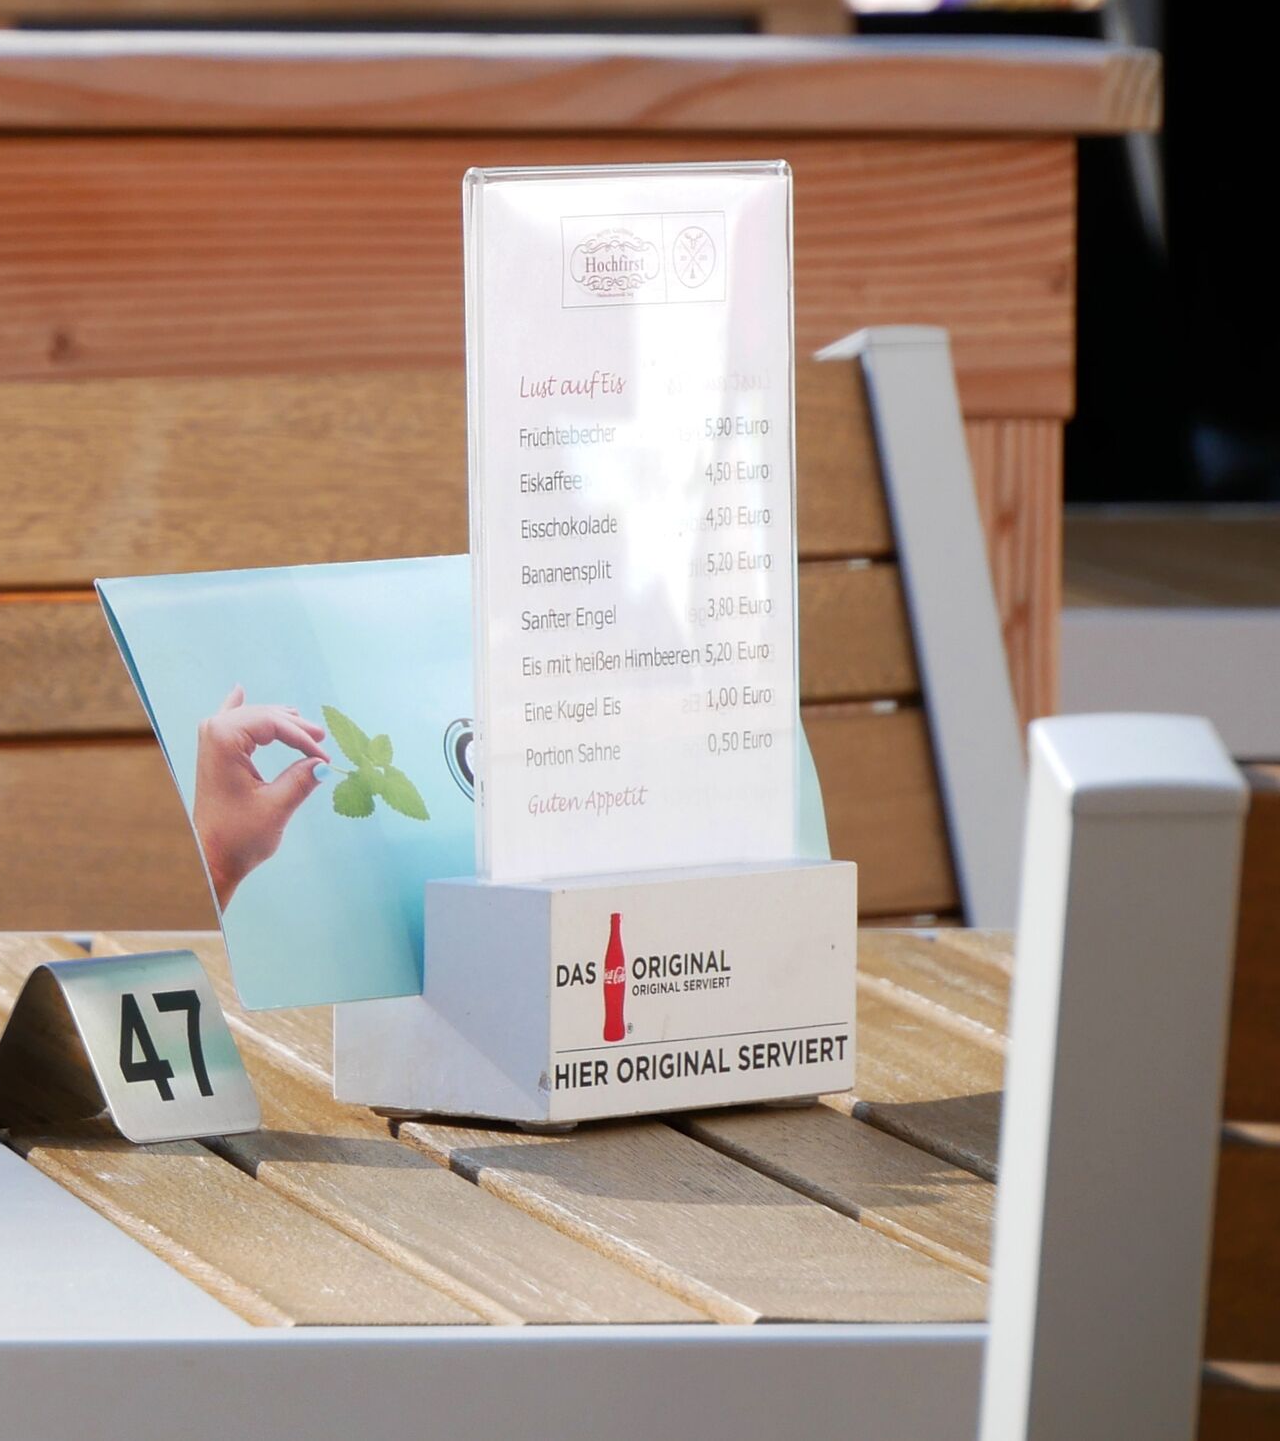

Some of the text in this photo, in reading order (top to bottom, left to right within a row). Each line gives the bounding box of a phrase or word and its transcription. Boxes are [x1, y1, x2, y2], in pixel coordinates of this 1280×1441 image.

[585, 254, 644, 274] Hochfirst
[520, 370, 627, 399] Lust auf Eis
[519, 416, 770, 448] Früchtebecher 5,90 Euro
[520, 461, 770, 494] Eiskaffee 4,50 Euro
[521, 505, 771, 540] Eisschokolade 4,50 Euro
[521, 551, 772, 585] Bananensplit 5,20 Euro
[521, 595, 772, 631] Sanfter Engel 3,80 Euro
[522, 641, 770, 676] Eis mit heißen Himbeeren 5,20 Euro
[524, 686, 772, 723] Eine Kugel Eis 1,00 Euro
[526, 730, 773, 767] Portion Sahne 0,50 Euro
[528, 786, 648, 817] Guten Appetit
[556, 961, 597, 988] DAS
[632, 949, 731, 981] ORIGINAL
[632, 976, 731, 996] ORIGINAL SERVIERT
[119, 989, 215, 1101] 47
[555, 1034, 849, 1090] HIER ORIGINAL SERVIERT
